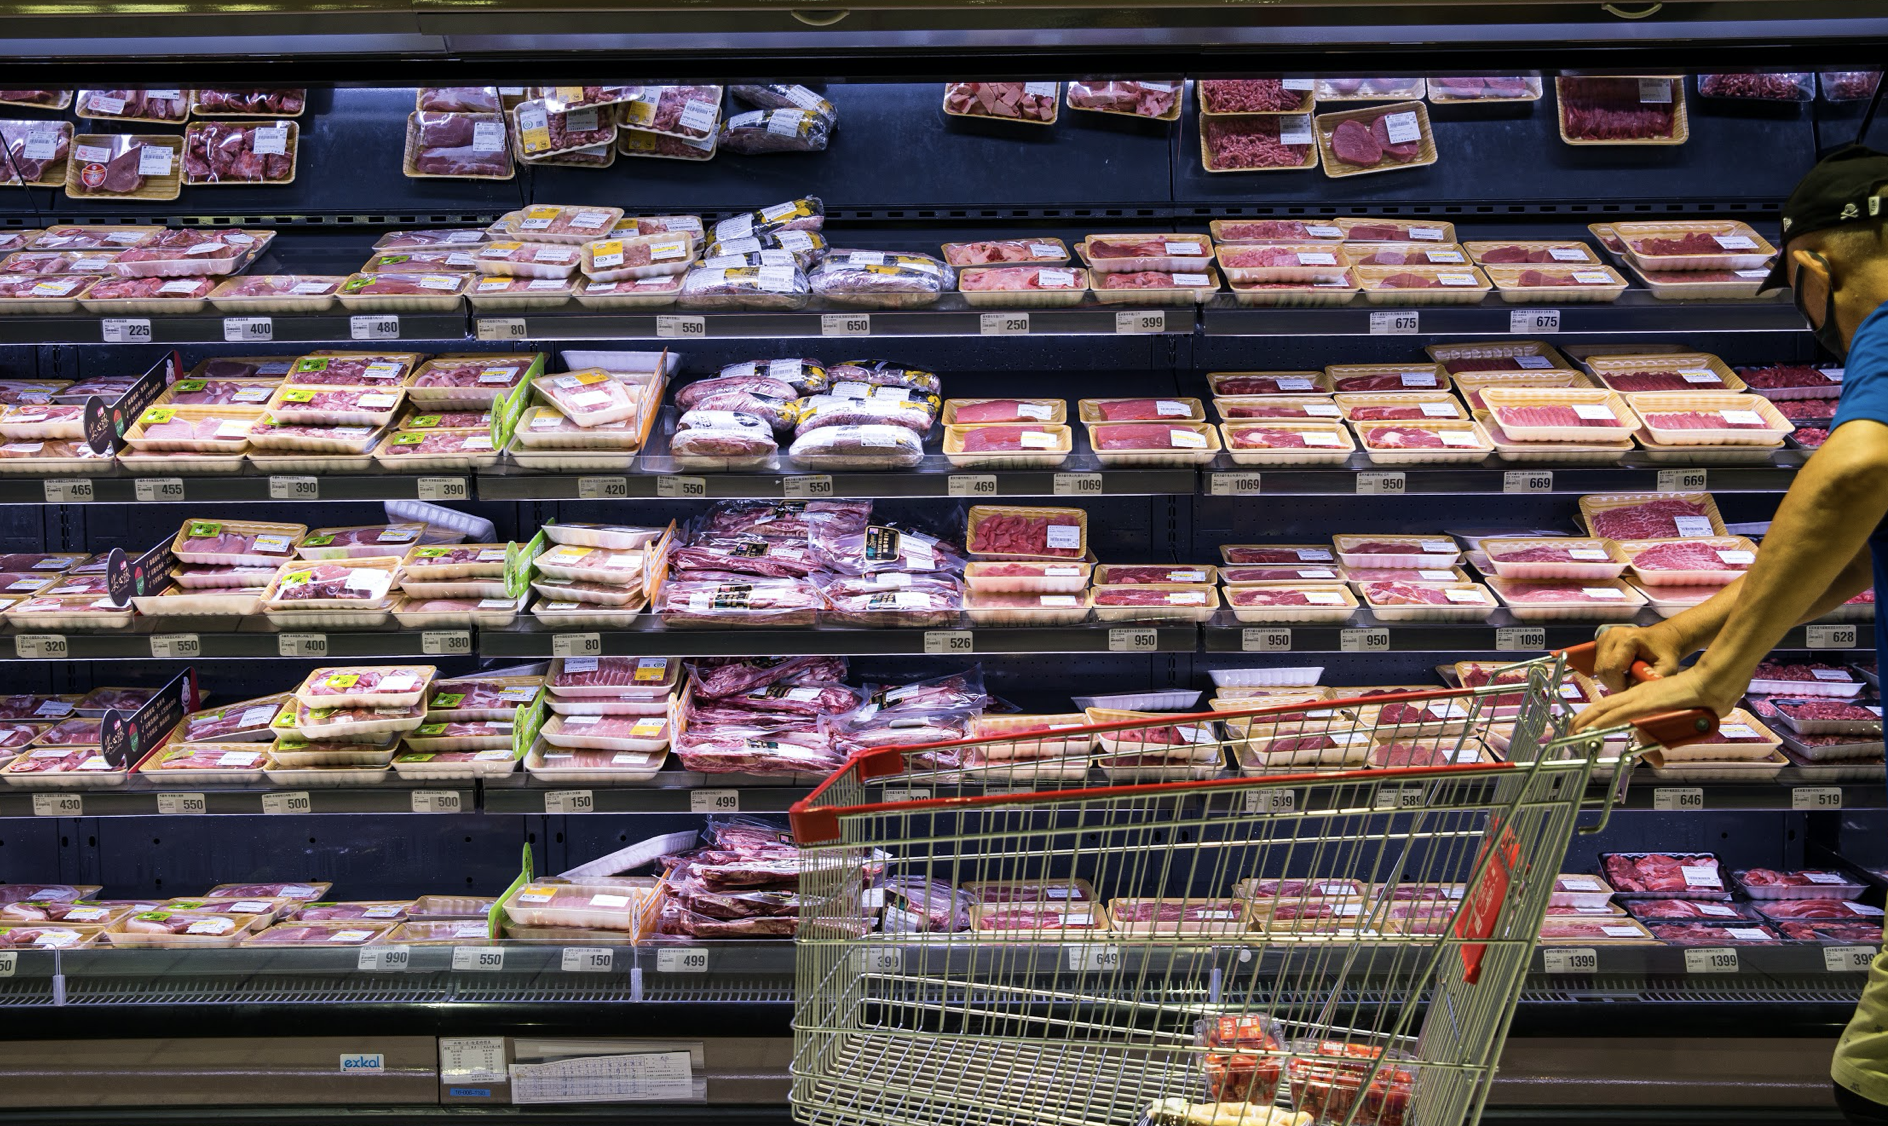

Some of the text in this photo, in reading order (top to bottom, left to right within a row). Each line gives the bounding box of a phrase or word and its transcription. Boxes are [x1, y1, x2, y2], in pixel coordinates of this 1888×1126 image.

[847, 320, 867, 331] 650
[1006, 319, 1027, 330] 250
[1142, 317, 1163, 328] 399
[1395, 318, 1416, 329] 675
[1536, 316, 1557, 327] 675
[129, 325, 150, 336] 225
[250, 323, 271, 334] 400
[377, 322, 398, 333] 480
[510, 324, 525, 335] 80
[682, 322, 703, 333] 550
[1077, 479, 1101, 490] 1069
[1235, 479, 1259, 490] 1069
[1382, 479, 1403, 489] 950
[1530, 478, 1551, 488] 669
[1683, 475, 1705, 486] 669
[71, 485, 91, 495] 465
[161, 484, 182, 495] 455
[296, 482, 316, 493] 390
[443, 484, 464, 495] 390
[605, 484, 625, 495] 420
[683, 483, 703, 495] 550
[809, 482, 830, 493] 550
[974, 481, 995, 492] 469
[1135, 635, 1155, 646] 950
[1268, 635, 1289, 645] 950
[1367, 635, 1387, 646] 950
[1520, 634, 1544, 645] 1099
[1833, 631, 1854, 642] 628
[45, 641, 65, 652] 320
[177, 640, 198, 651] 550
[305, 640, 325, 651] 400
[448, 637, 468, 648] 380
[585, 639, 599, 650] 80
[950, 638, 971, 648] 526
[60, 799, 80, 809] 430
[183, 799, 203, 810] 550
[288, 798, 308, 809] 500
[438, 797, 458, 807] 500
[571, 796, 591, 807] 150
[716, 796, 736, 807] 499
[1680, 794, 1701, 805] 646
[1819, 794, 1840, 805] 519
[385, 952, 407, 963] 990
[479, 954, 501, 965] 550
[590, 955, 611, 966] 150
[683, 955, 705, 967] 499
[877, 956, 899, 968] 399
[1096, 953, 1117, 965] 649
[1569, 955, 1595, 967] 1399
[1711, 955, 1737, 967] 1399
[344, 1056, 380, 1068] exkal
